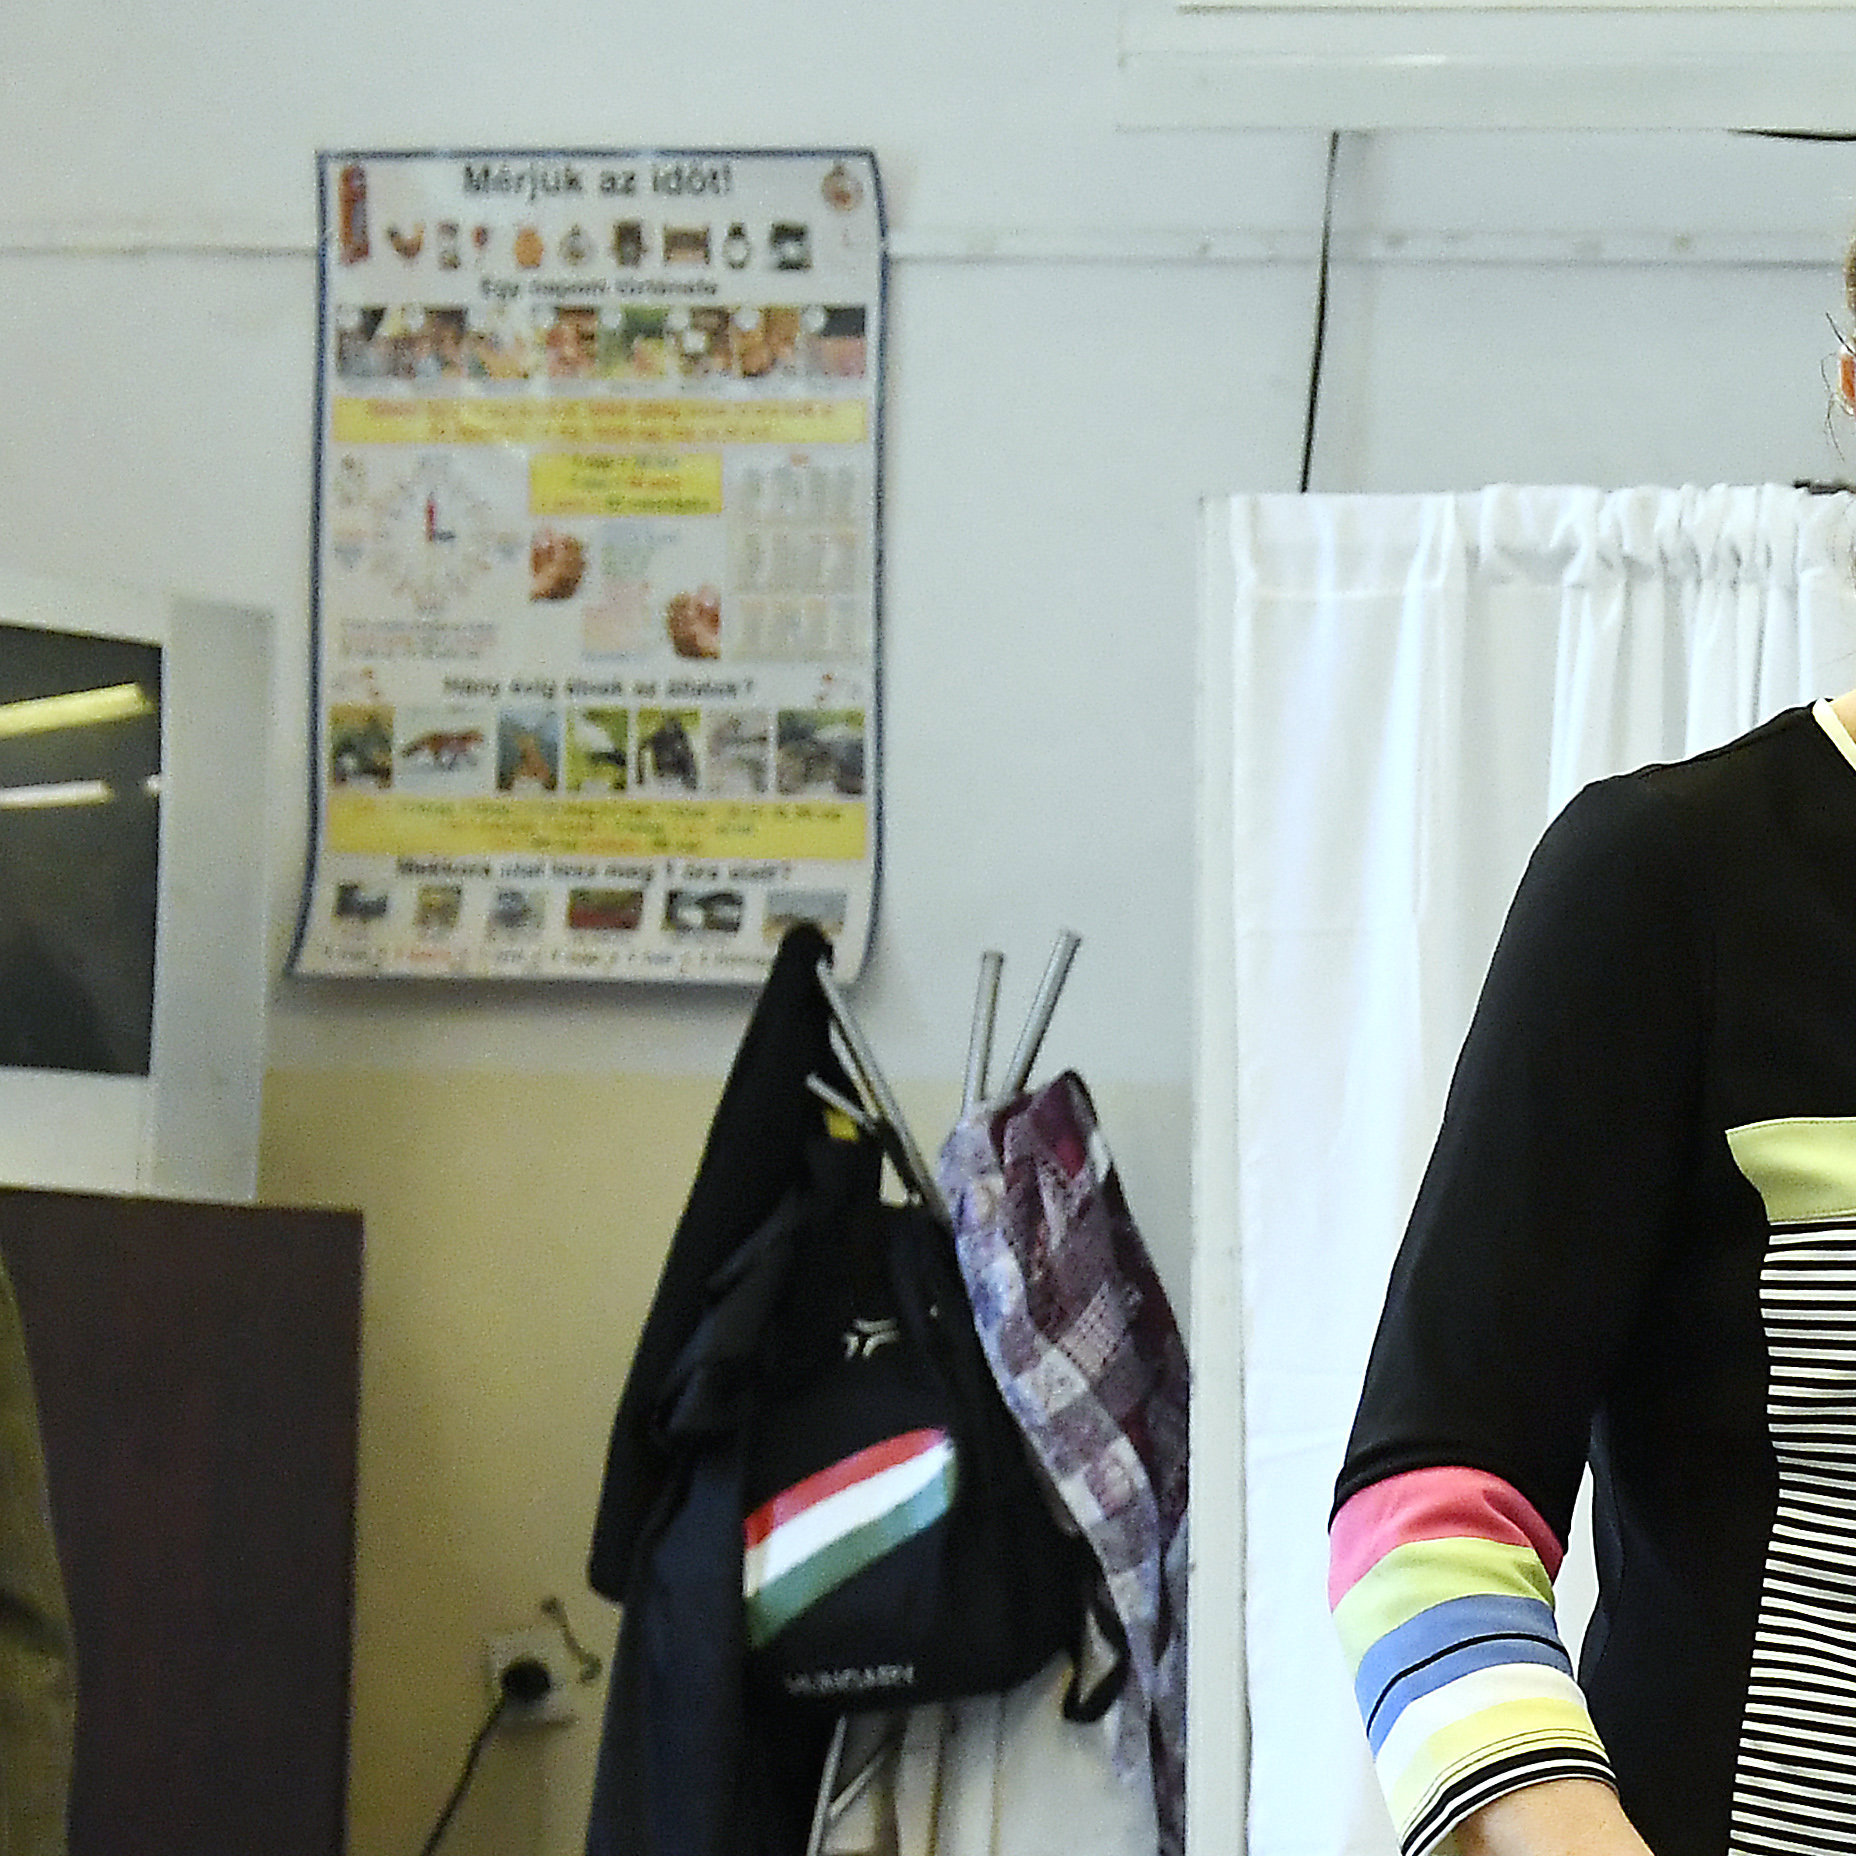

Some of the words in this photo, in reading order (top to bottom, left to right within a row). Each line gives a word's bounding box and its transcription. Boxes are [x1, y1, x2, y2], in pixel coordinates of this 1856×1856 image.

[463, 162, 583, 201] Mérjük
[600, 169, 637, 197] az
[652, 161, 731, 197] időt!
